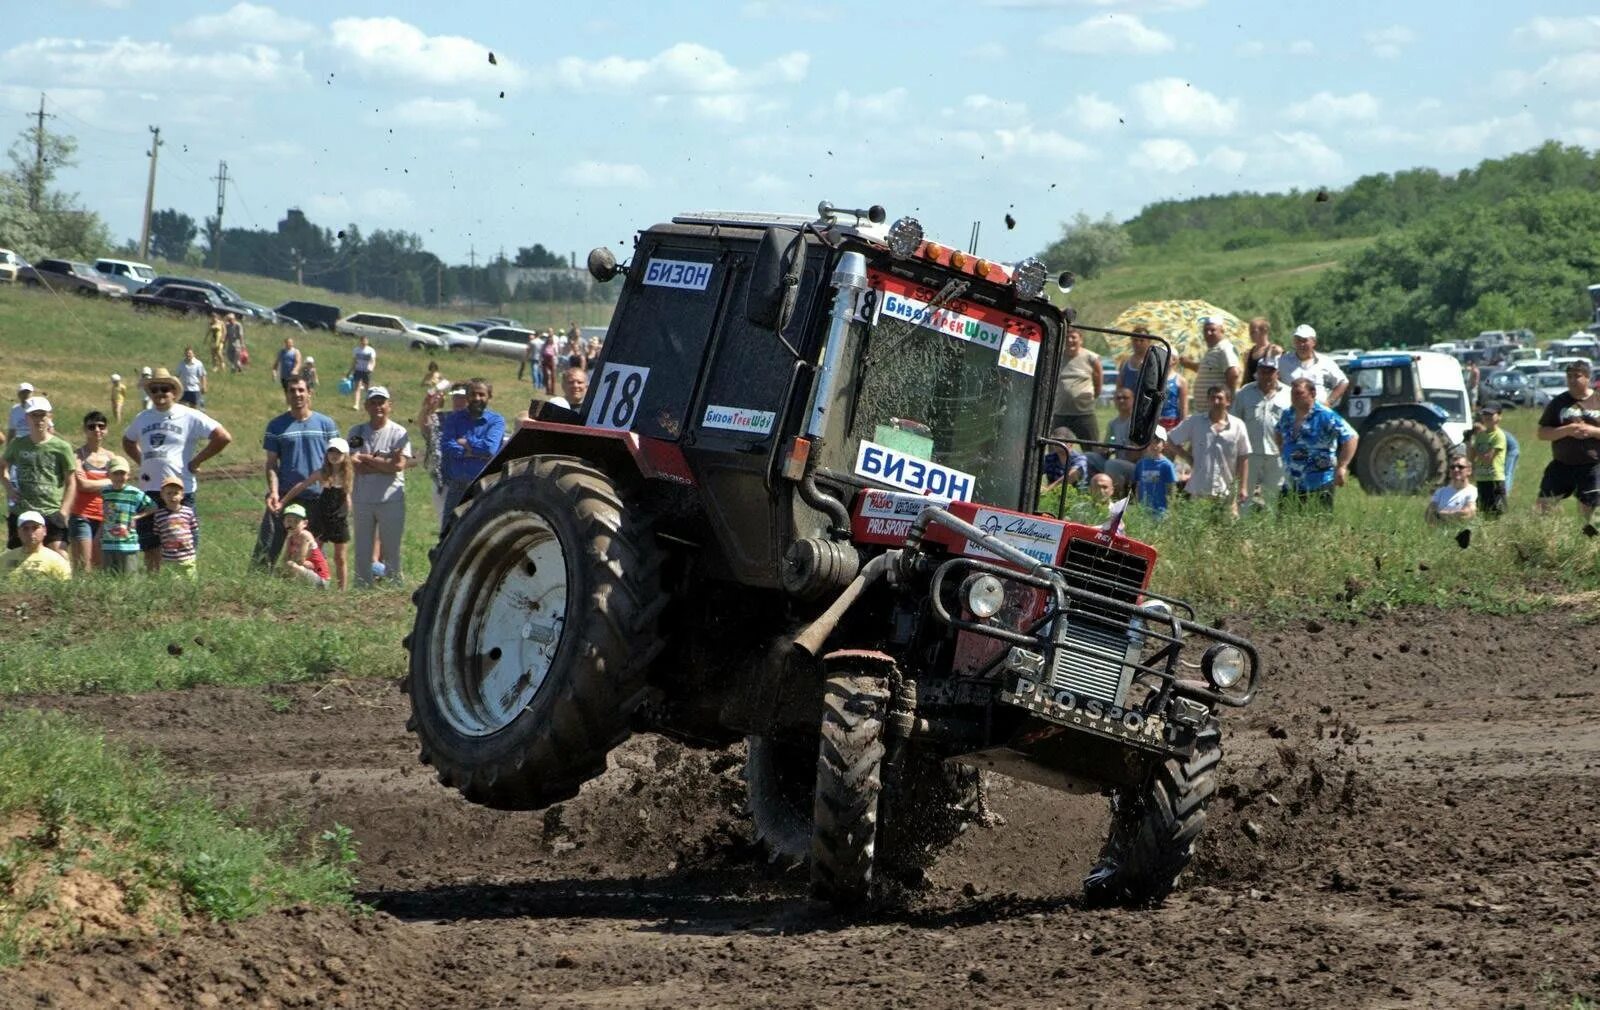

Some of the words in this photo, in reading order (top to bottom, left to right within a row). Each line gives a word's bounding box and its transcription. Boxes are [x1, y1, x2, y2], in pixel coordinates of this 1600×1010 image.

[647, 262, 709, 286] БИЗОН
[596, 370, 642, 428] 18
[1355, 400, 1364, 416] 9
[862, 447, 969, 502] БИЗОН
[866, 518, 913, 537] PRO.SPORT
